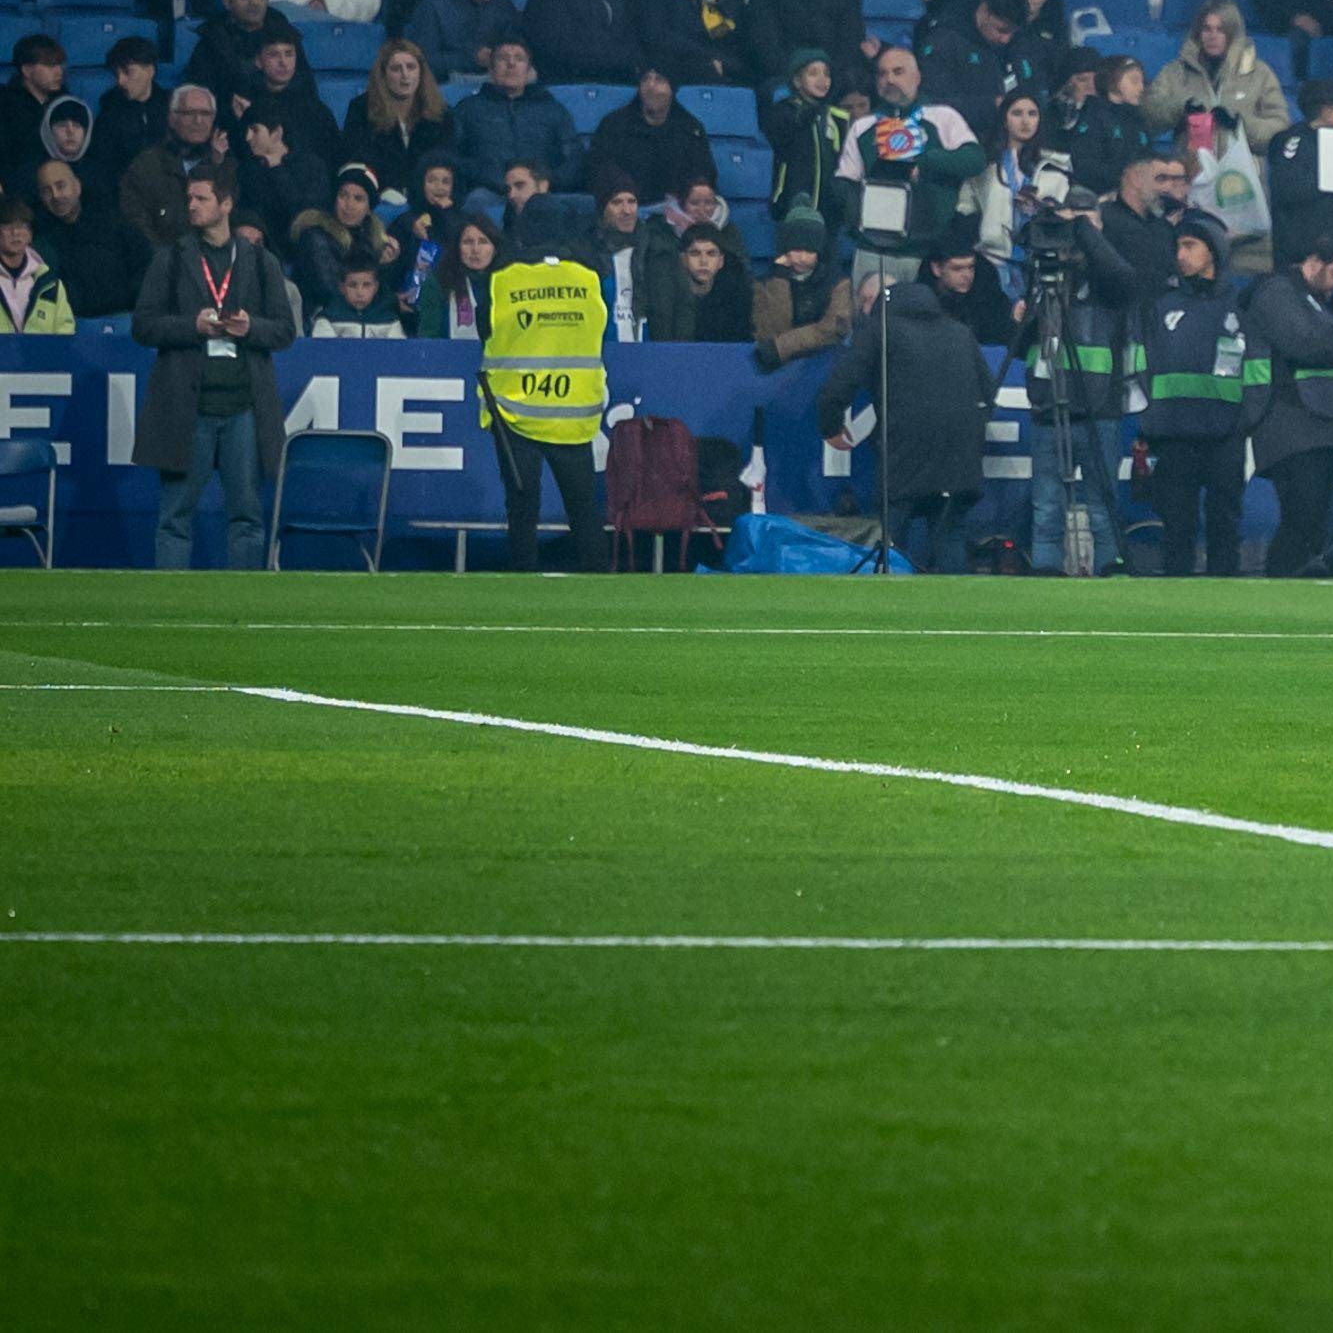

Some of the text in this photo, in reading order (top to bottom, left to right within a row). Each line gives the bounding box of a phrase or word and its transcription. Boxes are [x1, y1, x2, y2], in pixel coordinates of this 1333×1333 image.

[510, 286, 589, 304] SEGURETAT
[537, 311, 585, 323] PROTECTA
[521, 372, 571, 399] 040
